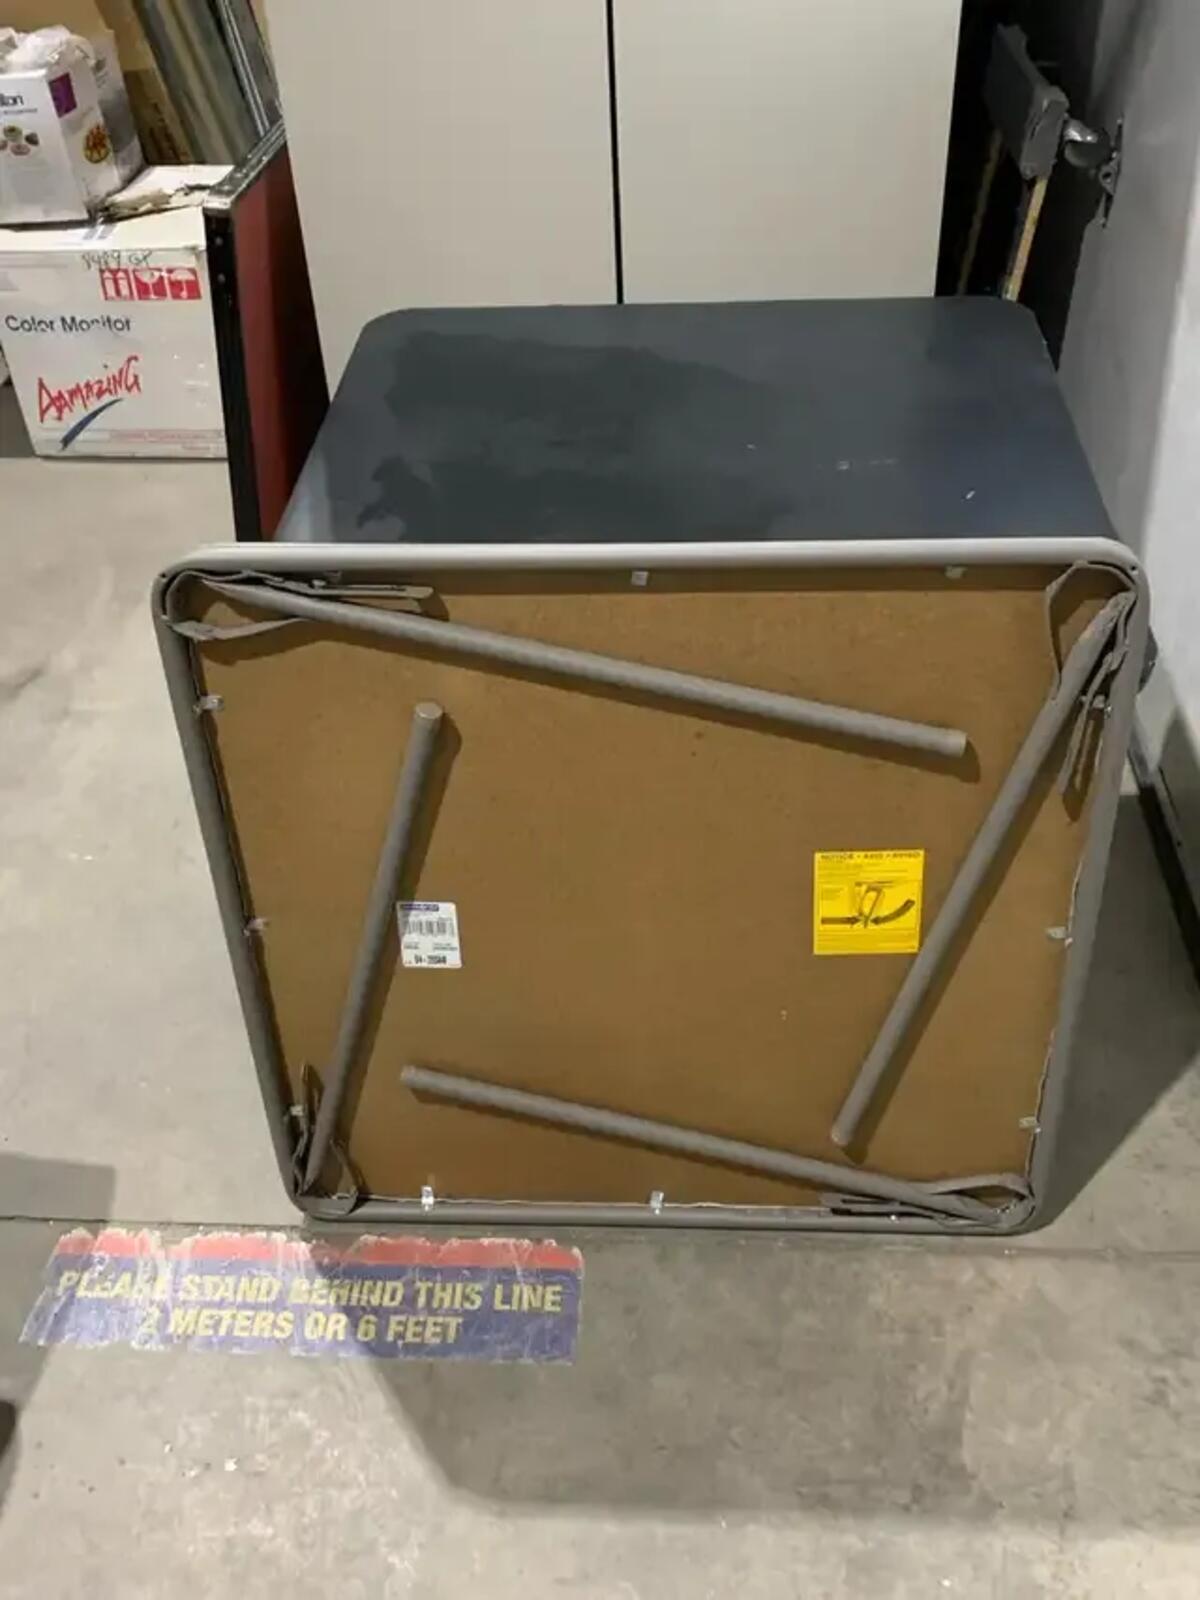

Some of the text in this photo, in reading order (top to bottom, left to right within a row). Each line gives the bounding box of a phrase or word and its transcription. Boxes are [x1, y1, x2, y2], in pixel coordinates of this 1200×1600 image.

[4, 315, 131, 332] Color Monitor
[178, 1273, 283, 1302] STAND
[289, 1277, 404, 1307] BEHIND
[414, 1280, 484, 1311] THIS
[493, 1282, 563, 1312] LINE
[168, 1308, 295, 1339] METERS
[303, 1311, 348, 1341] OR
[356, 1314, 378, 1342] 6
[386, 1315, 464, 1344] FEET
